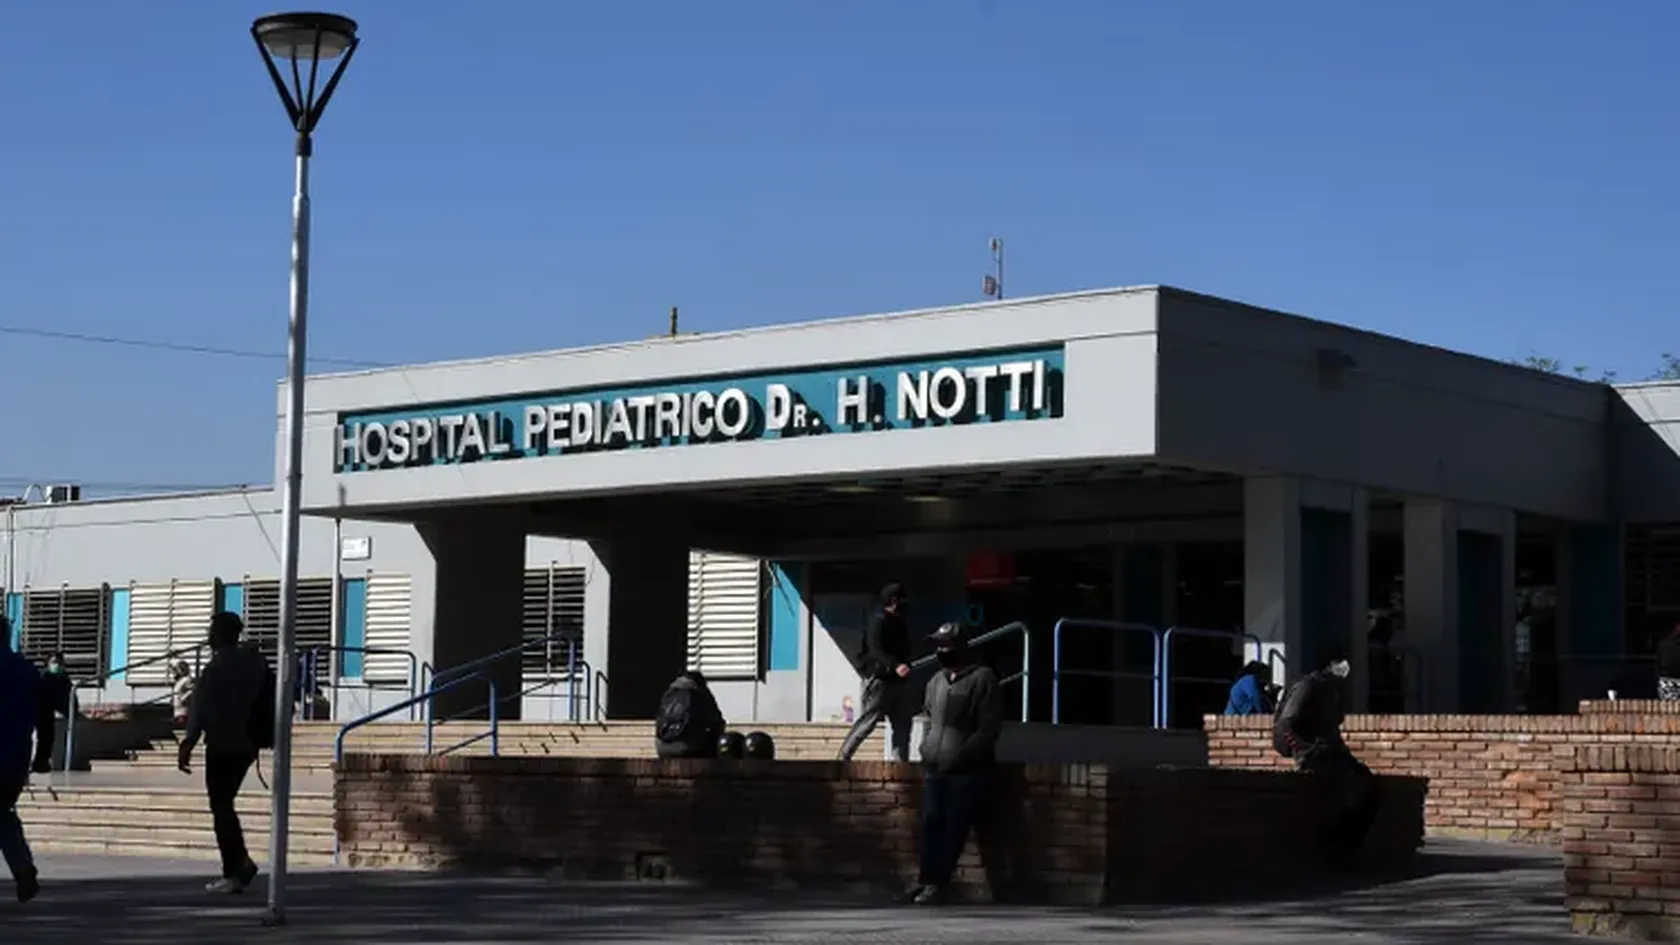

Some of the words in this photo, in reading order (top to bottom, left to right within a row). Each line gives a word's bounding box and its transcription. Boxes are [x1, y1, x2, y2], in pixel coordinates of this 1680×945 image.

[337, 413, 509, 466] HOSPITAL
[524, 388, 750, 450] PEDIATRICO
[837, 375, 882, 424] H.
[897, 359, 1045, 420] NOTTI
